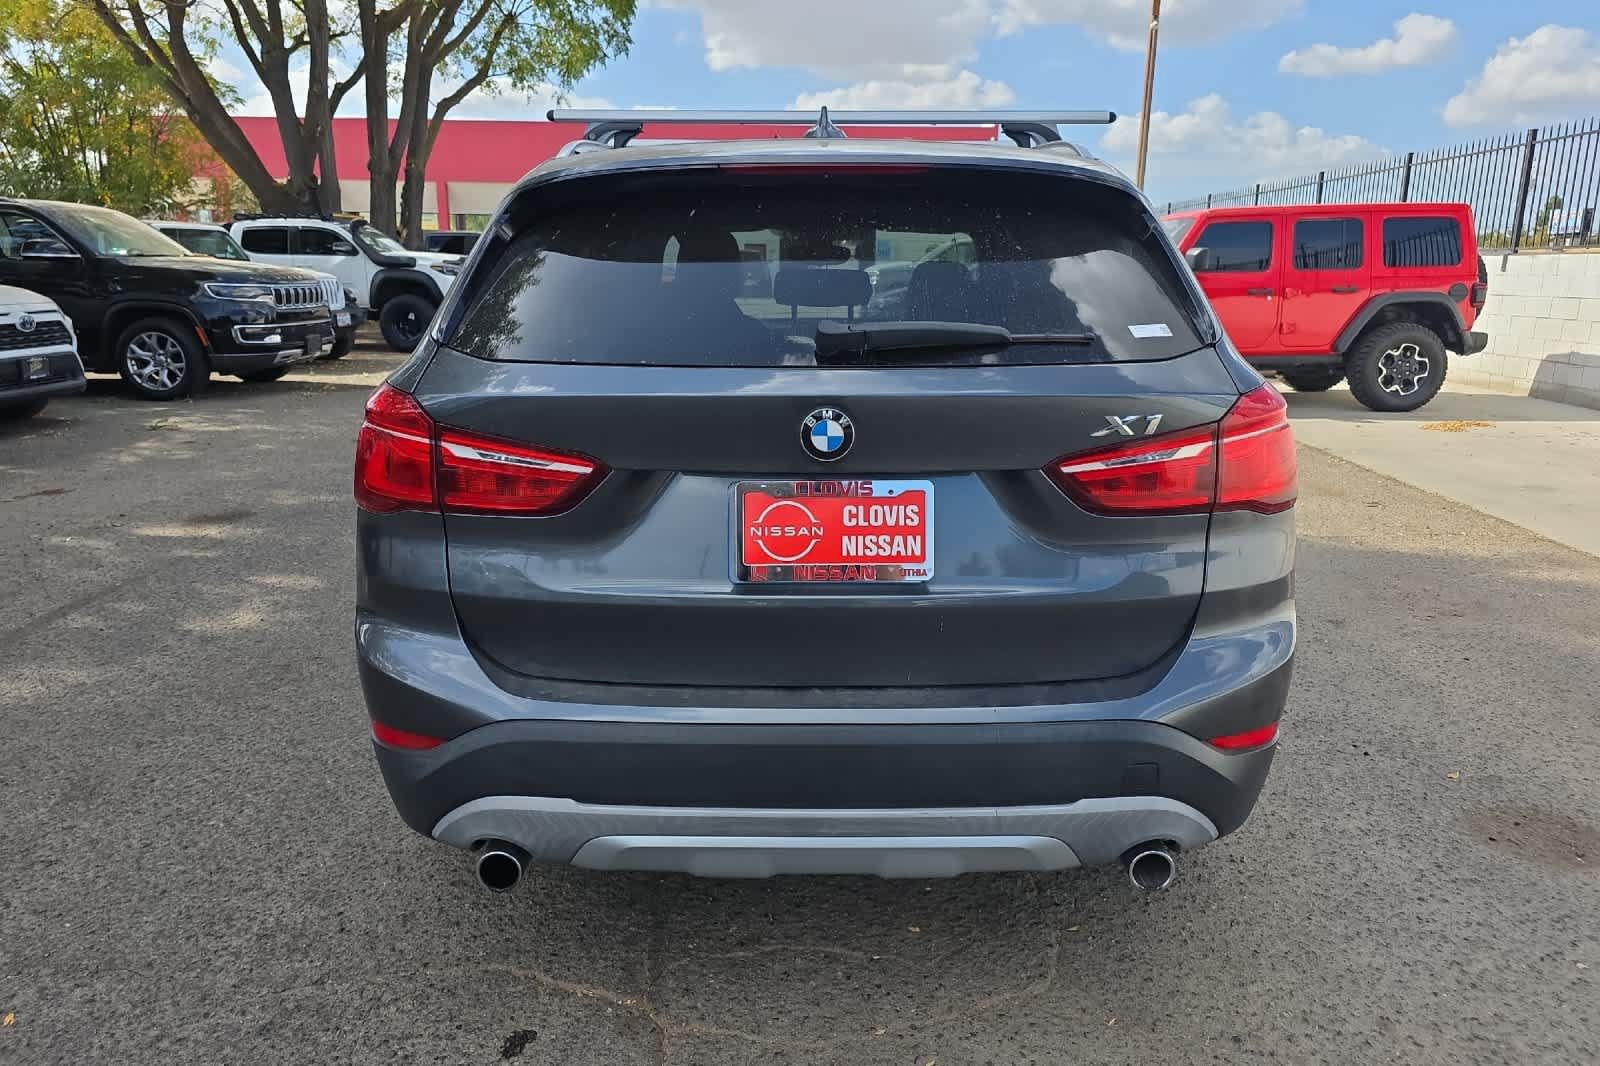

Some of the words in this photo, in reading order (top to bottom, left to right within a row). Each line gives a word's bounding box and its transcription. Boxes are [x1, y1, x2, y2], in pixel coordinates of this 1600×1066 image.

[805, 410, 849, 427] BMW
[1090, 414, 1164, 437] X1
[794, 481, 873, 496] CLOVIS
[843, 505, 919, 527] CLOVIS
[750, 526, 824, 537] NISSAN
[842, 535, 921, 556] NISSAN
[794, 566, 876, 581] NISSAN
